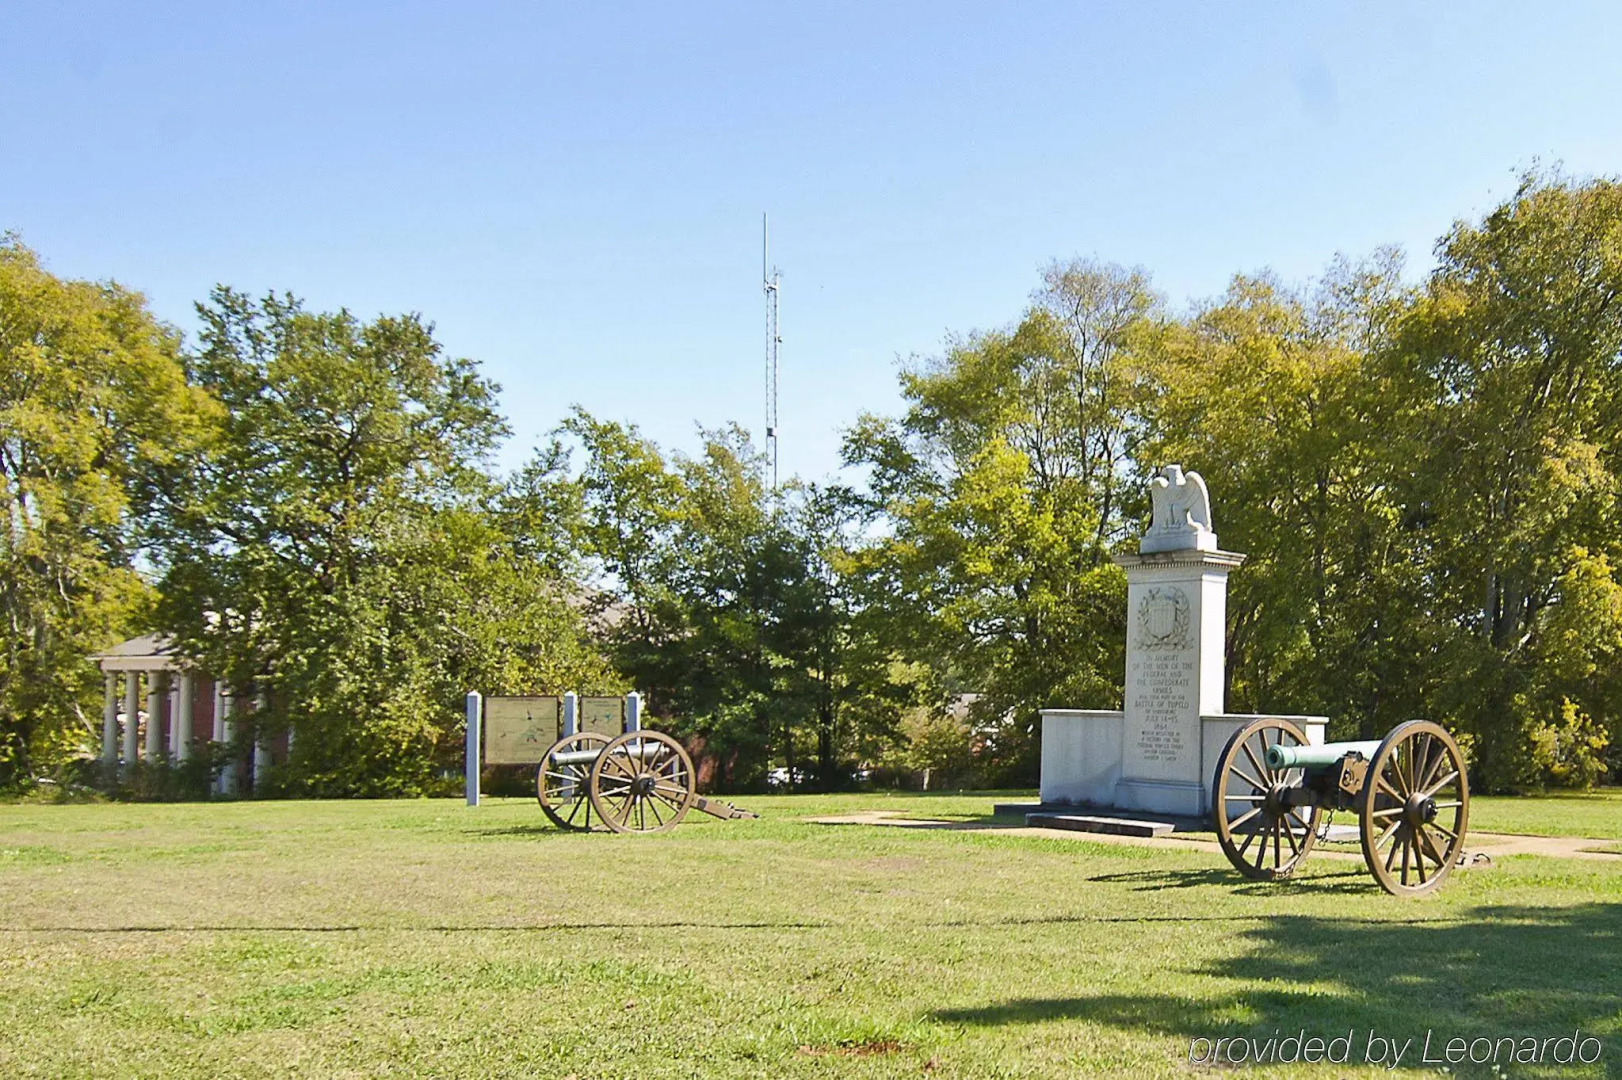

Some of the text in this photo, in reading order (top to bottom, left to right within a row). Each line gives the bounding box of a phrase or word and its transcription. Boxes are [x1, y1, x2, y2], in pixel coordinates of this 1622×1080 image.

[1182, 662, 1193, 670] THE
[1142, 670, 1182, 678] FEDERAL AND
[1136, 678, 1190, 686] THE CONFEDERATE
[1134, 700, 1153, 708] BATTLE
[1168, 701, 1190, 709] TUPELO
